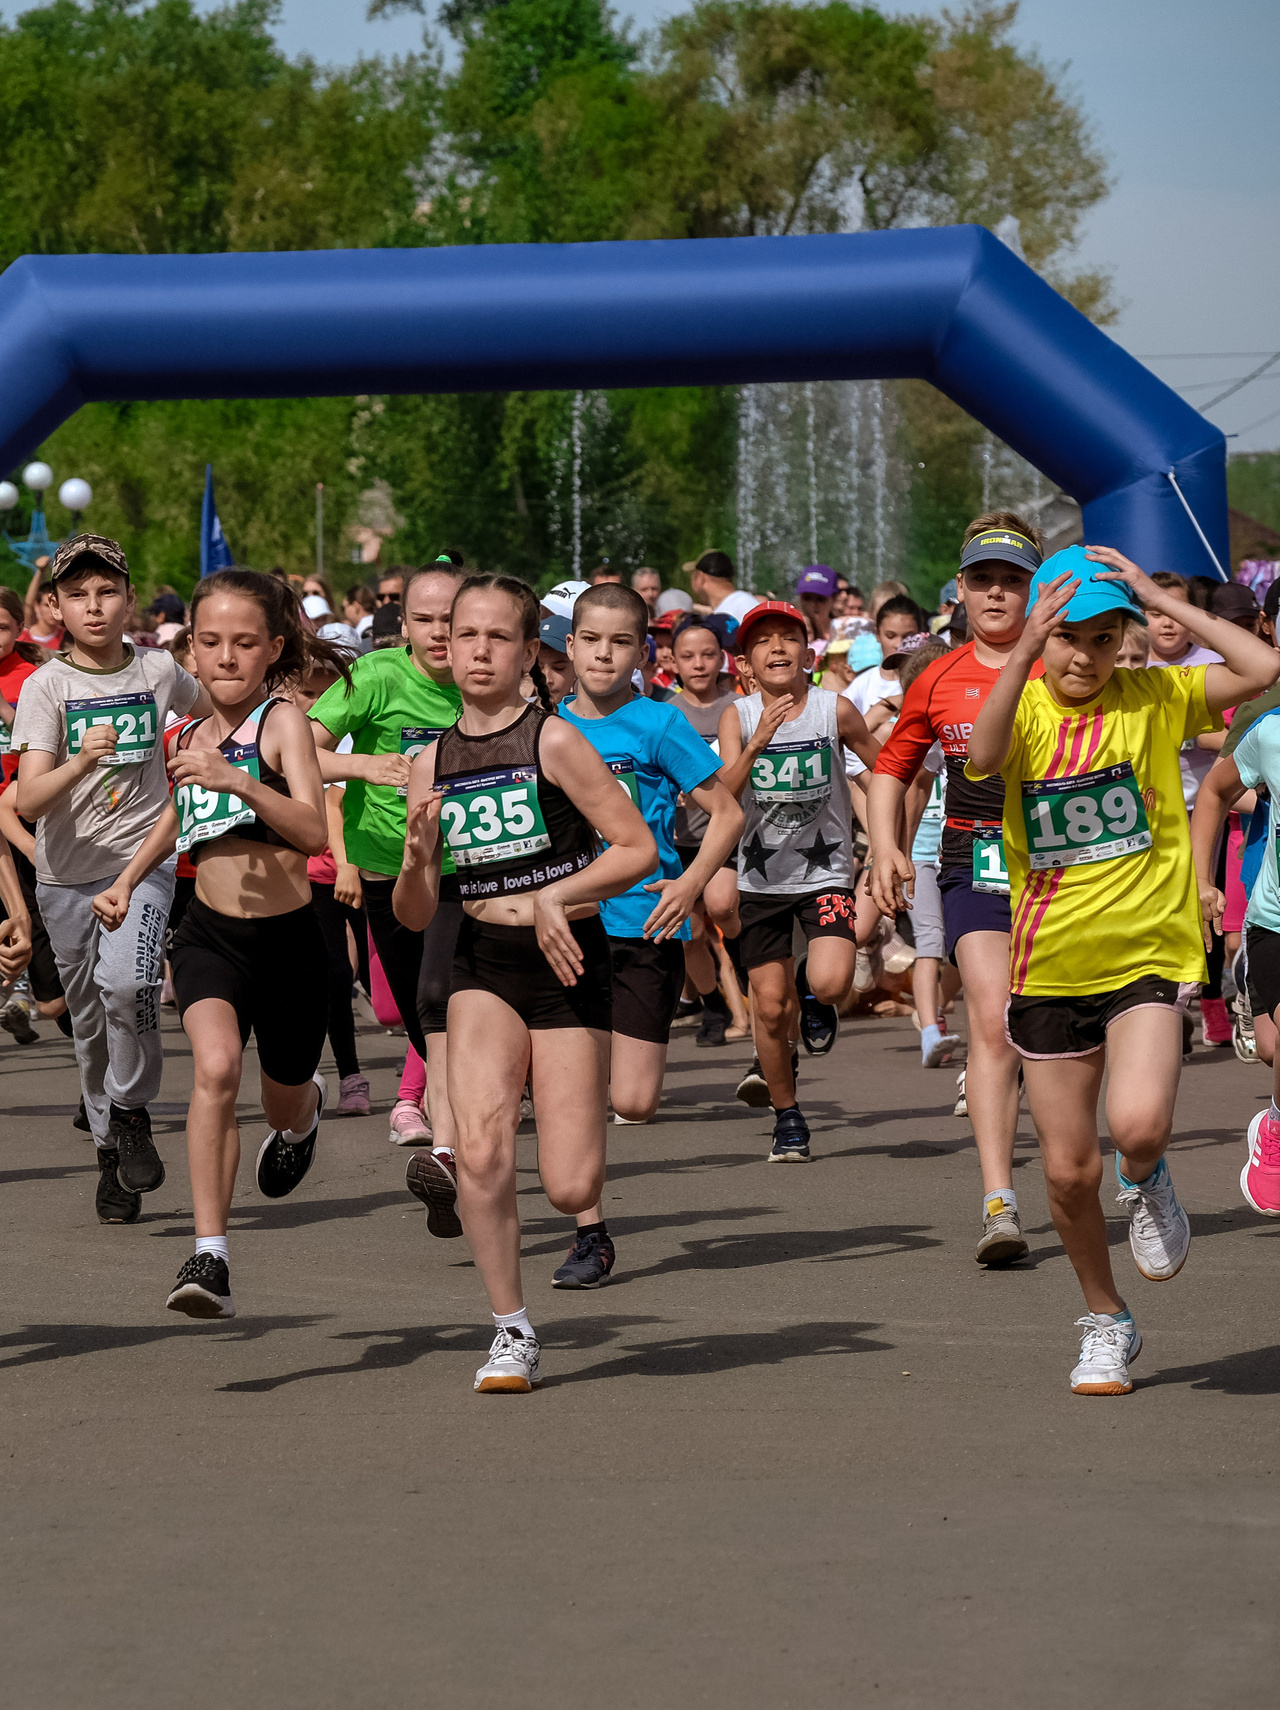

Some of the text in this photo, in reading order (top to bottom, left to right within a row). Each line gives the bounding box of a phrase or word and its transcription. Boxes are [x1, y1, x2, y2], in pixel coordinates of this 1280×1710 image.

[980, 535, 1024, 549] IRONMAN
[752, 753, 828, 788] 341
[441, 788, 535, 847] 235
[1030, 786, 1138, 848] 189
[460, 883, 470, 895] ve
[477, 880, 498, 894] love
[503, 876, 532, 890] love
[532, 869, 545, 884] is
[546, 861, 573, 880] love
